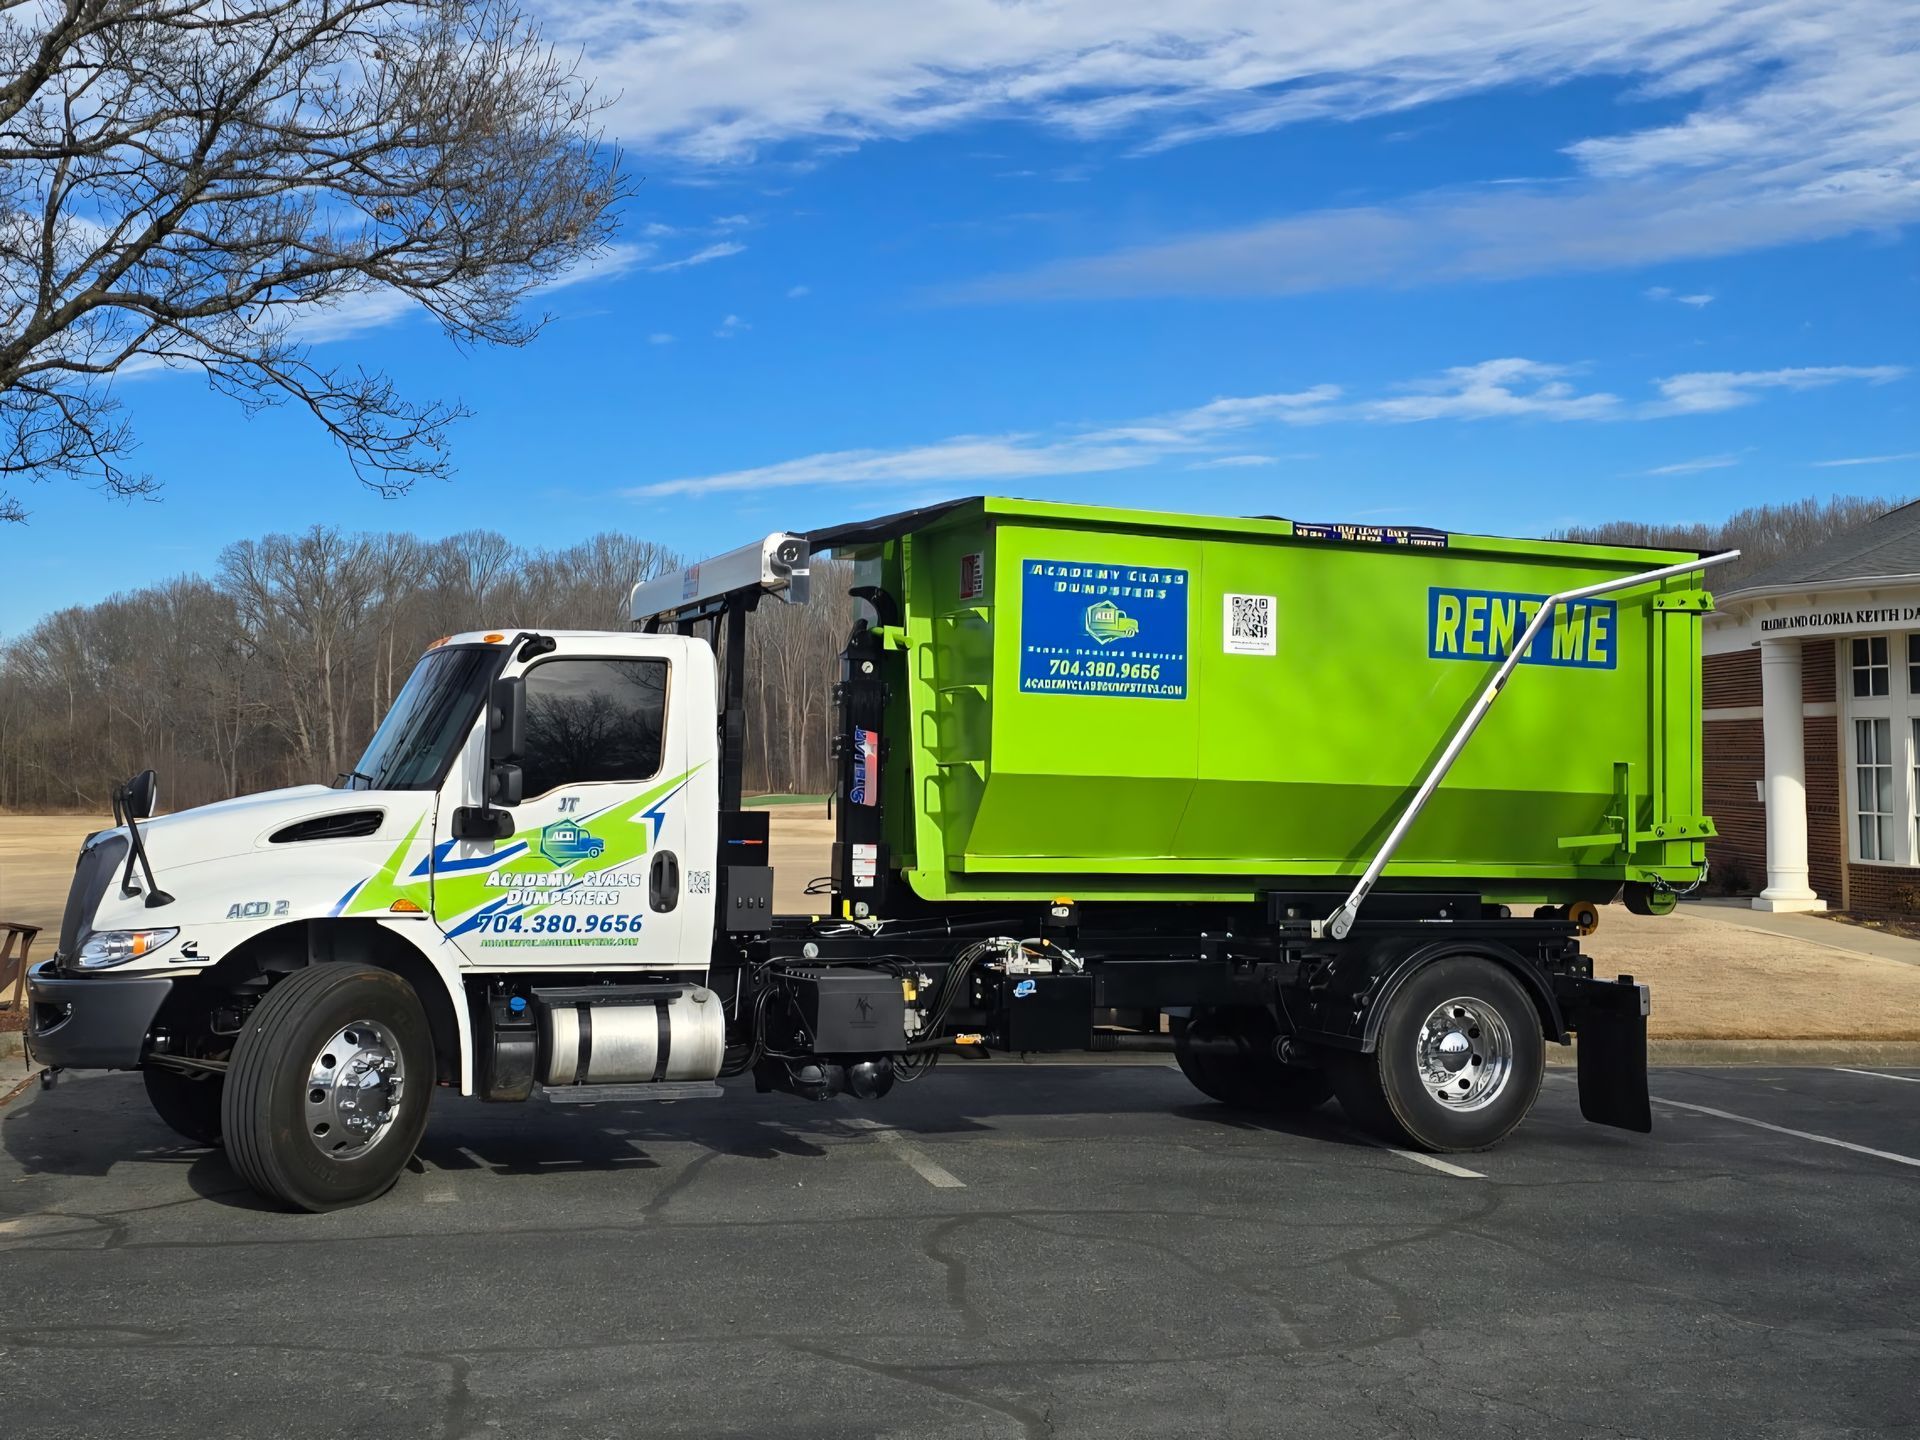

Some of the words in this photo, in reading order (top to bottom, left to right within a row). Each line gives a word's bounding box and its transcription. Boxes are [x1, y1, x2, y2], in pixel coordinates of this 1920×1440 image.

[1029, 564, 1120, 580] ACADEMY
[1054, 581, 1167, 600] DUMPSTERS
[1809, 611, 1854, 627] GLORIA
[1856, 608, 1899, 623] KEITH
[1435, 594, 1543, 657] RENT
[1551, 603, 1611, 662] ME
[1049, 659, 1161, 681] 704.380.9656
[557, 797, 580, 813] JT
[484, 869, 574, 888] ACADEMY
[582, 870, 641, 888] CLASS
[506, 888, 620, 906] DUMPSTERS
[226, 901, 270, 919] ACD
[274, 899, 290, 916] 2
[477, 914, 643, 934] 704.380.9656
